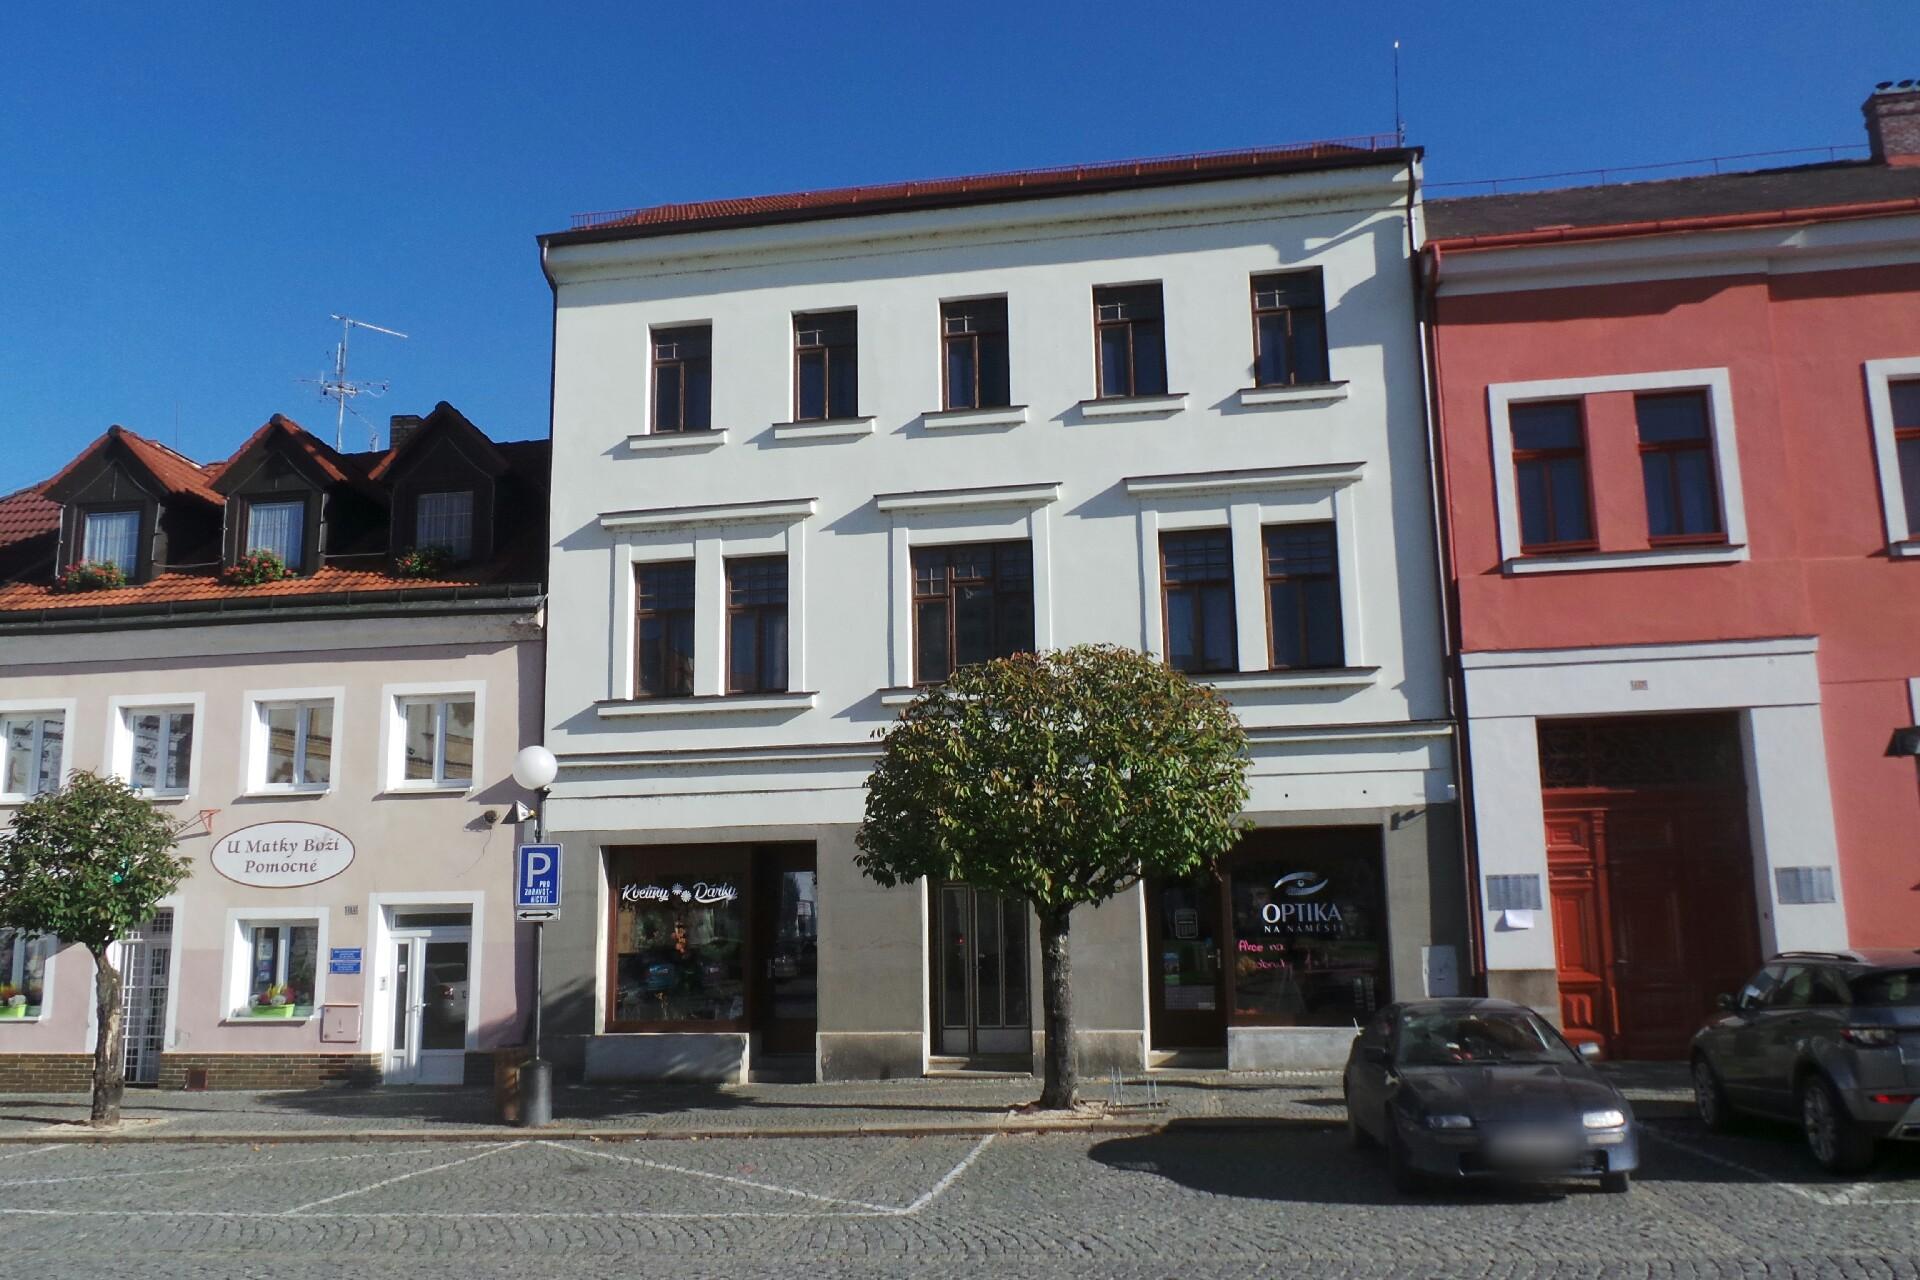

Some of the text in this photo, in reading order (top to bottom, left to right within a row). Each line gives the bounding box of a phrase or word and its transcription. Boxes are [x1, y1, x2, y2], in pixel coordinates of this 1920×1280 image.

[227, 837, 340, 858] U Matky Boží
[244, 858, 318, 874] Pomocné
[527, 852, 551, 888] P
[539, 880, 551, 888] PRO
[693, 882, 738, 904] Dárky
[1262, 903, 1342, 924] OPTIKA
[1264, 925, 1281, 934] NA
